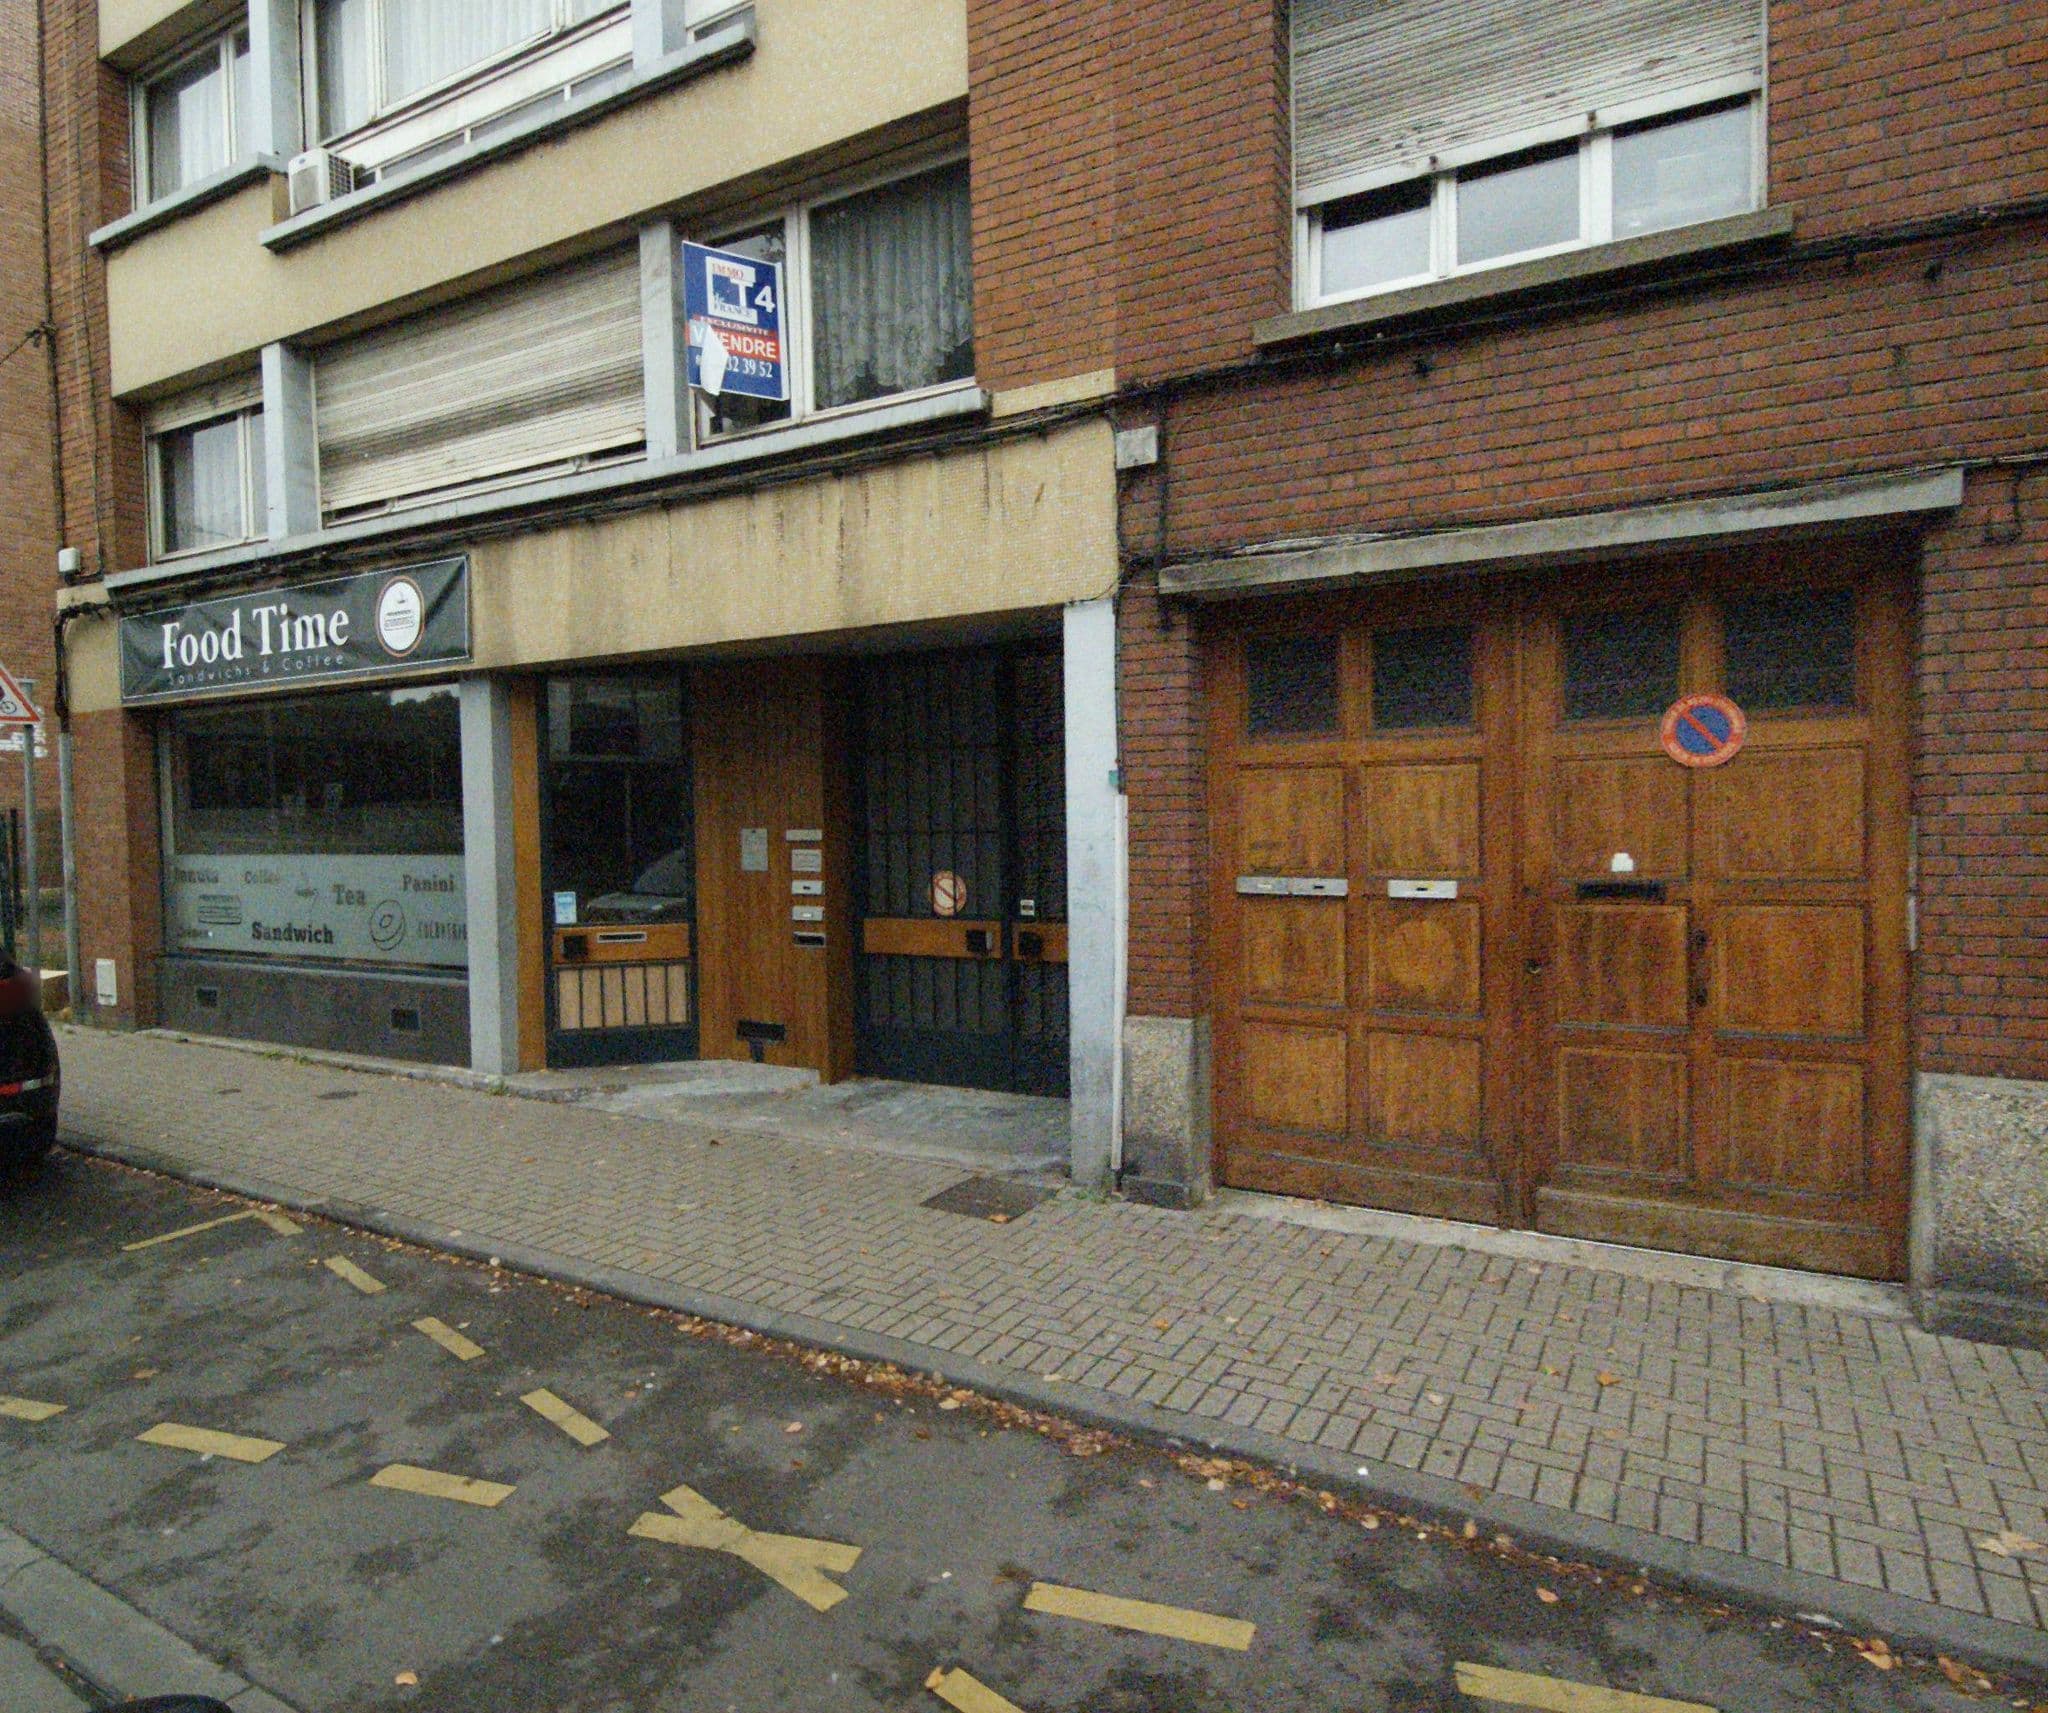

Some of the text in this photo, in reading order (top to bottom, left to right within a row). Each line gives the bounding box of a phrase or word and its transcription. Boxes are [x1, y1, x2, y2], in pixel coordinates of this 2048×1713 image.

[712, 262, 744, 281] IMMO
[161, 602, 350, 670] Food Time
[402, 872, 455, 893] Panini
[331, 883, 367, 906] Tea
[251, 920, 335, 945] Sandwich
